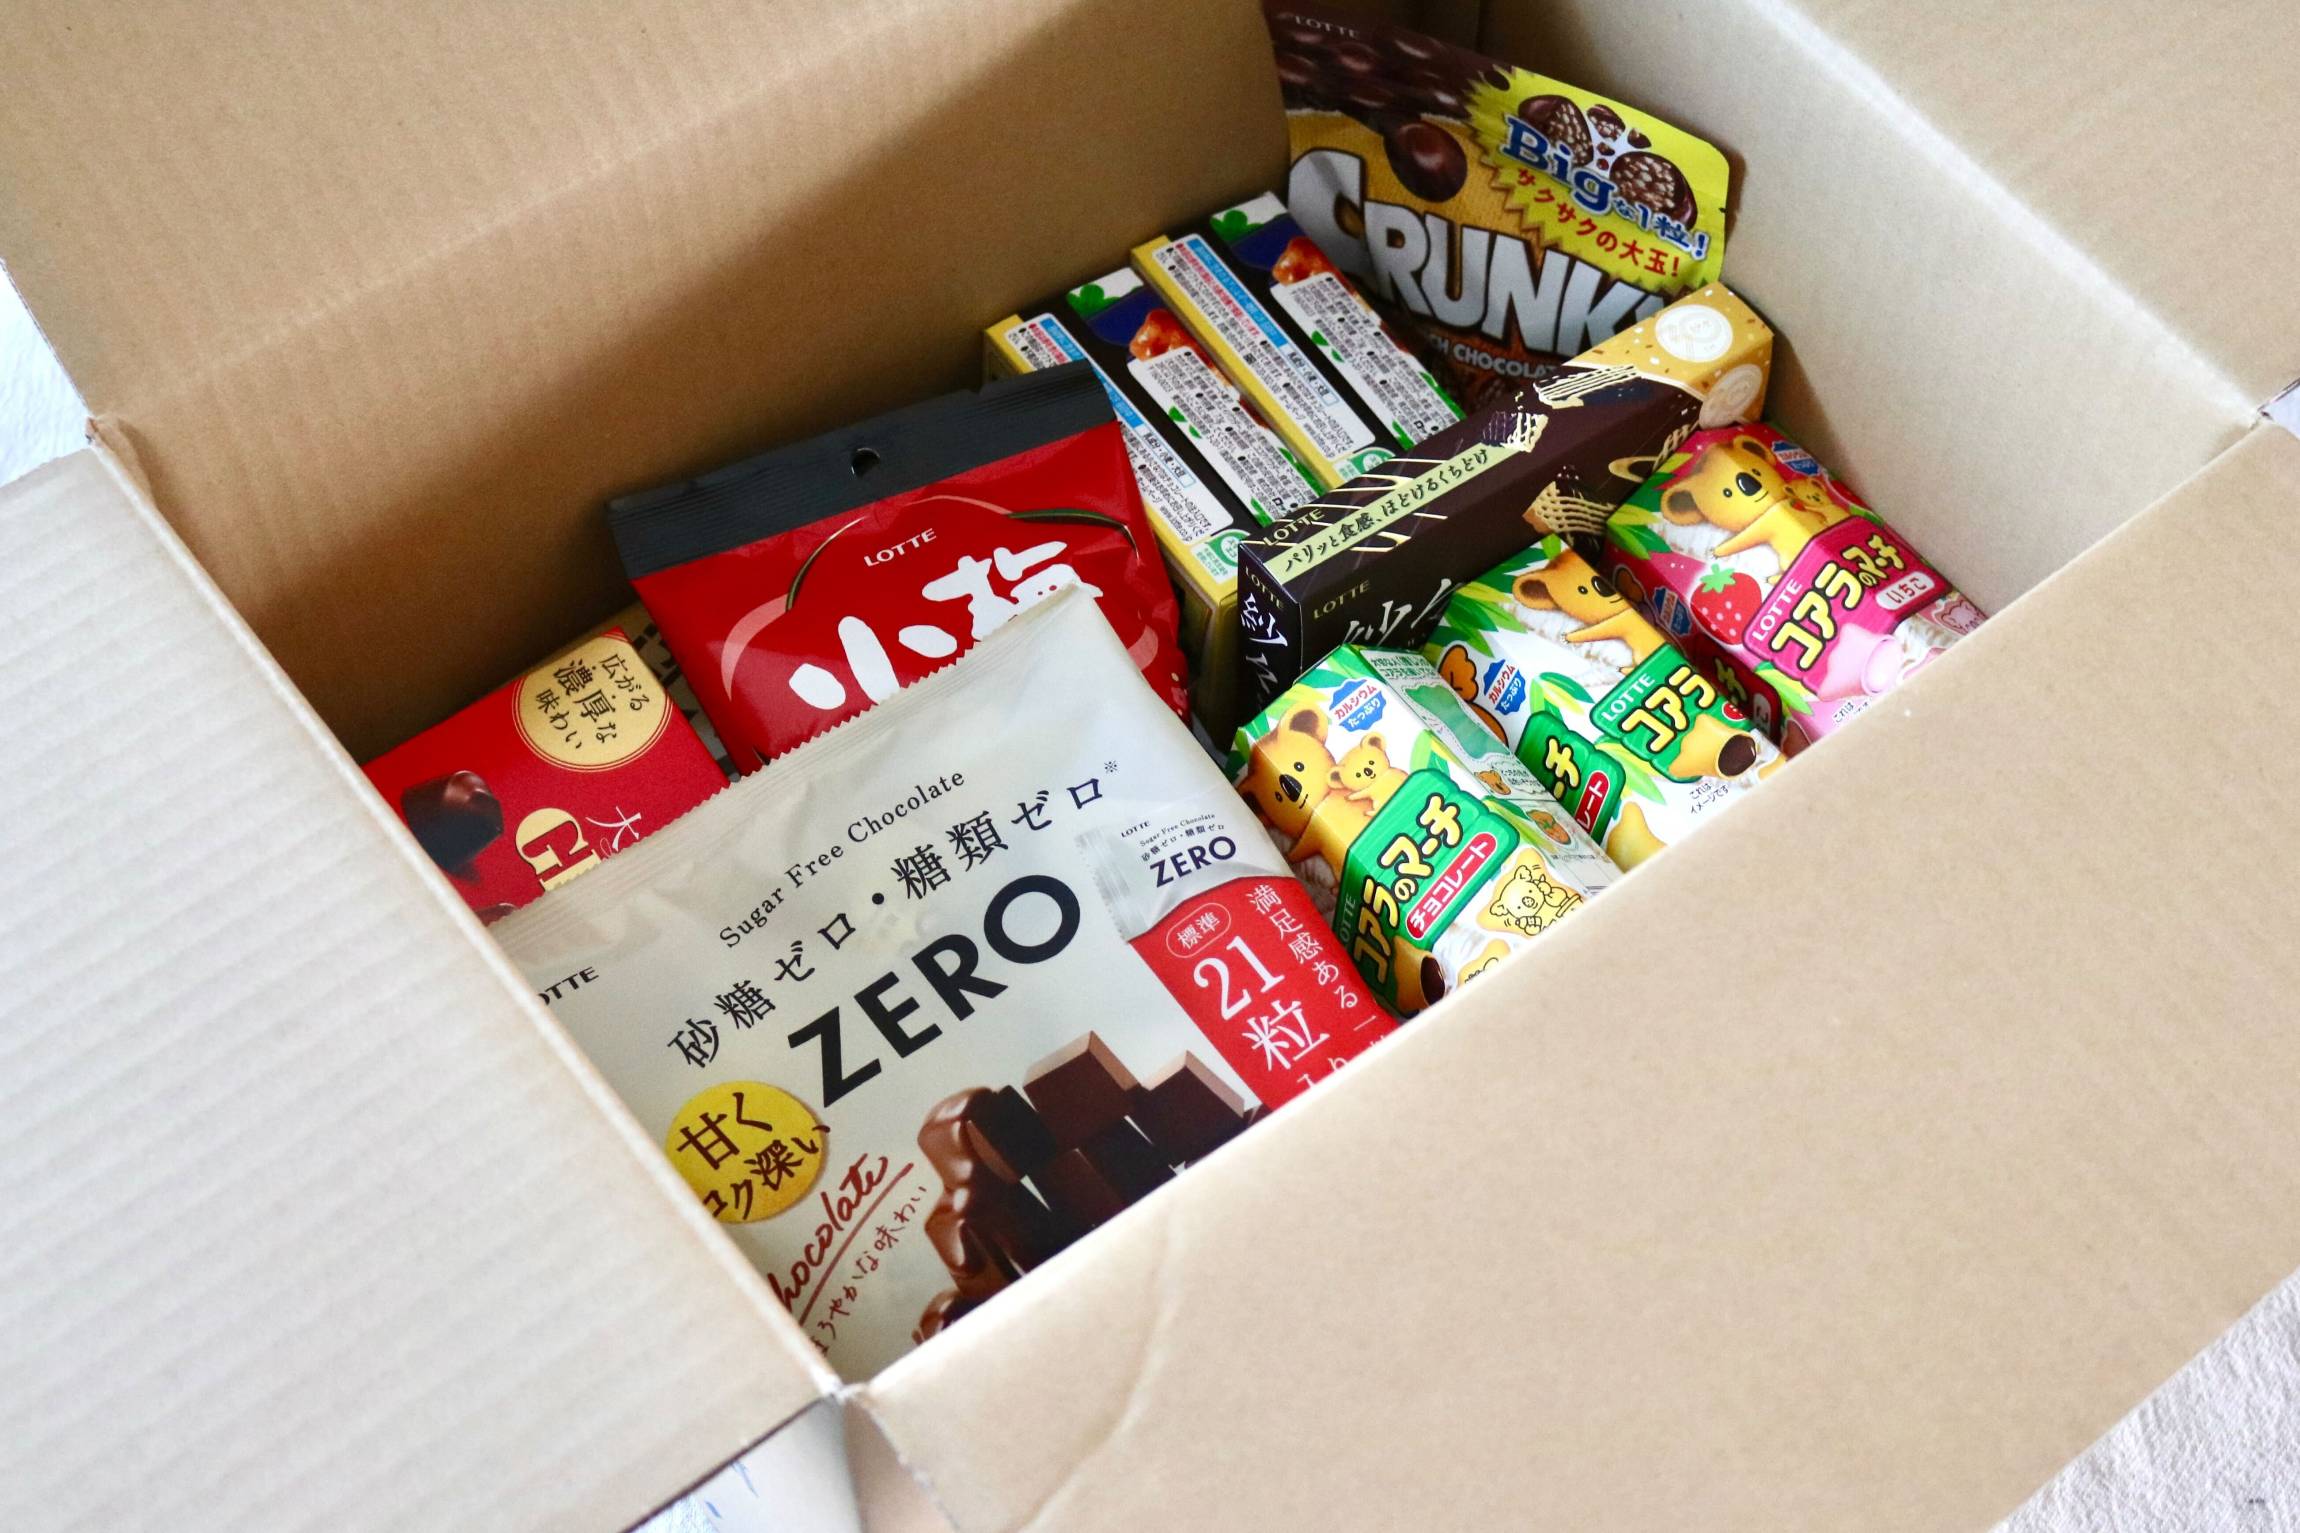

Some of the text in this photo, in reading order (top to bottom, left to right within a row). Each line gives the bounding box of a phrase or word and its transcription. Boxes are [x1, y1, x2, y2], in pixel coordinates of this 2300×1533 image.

[1516, 167, 1682, 278] サクサクの大玉!
[1288, 148, 1666, 360] CRUNK
[864, 528, 938, 567] LOTTE
[1262, 507, 1326, 548] LOTTE
[1245, 566, 1285, 610] LOTTE
[1313, 579, 1371, 620] LOTTE
[1750, 578, 1805, 643] LOTTE
[1770, 533, 1906, 672] コアラのマーチ
[553, 658, 618, 744] 濃厚な
[600, 654, 650, 712] 広がる
[1334, 684, 1378, 721] カルシウム
[1487, 663, 1517, 705] カルシウム
[1502, 675, 1523, 713] たっぷり
[1601, 672, 1656, 725] LOTTE
[1620, 665, 1718, 755] コアラ
[535, 688, 583, 750] 味わい
[1347, 698, 1382, 728] たっぷり
[1688, 782, 1713, 801] これは
[1690, 784, 1730, 815] イメージです
[1121, 820, 1151, 838] LOTTE
[1139, 813, 1216, 848] Sugar Free Chocolate
[718, 768, 966, 950] Sugar Free Chocolate
[1149, 835, 1237, 888] ZERO
[1411, 838, 1491, 934] チョコレート
[1353, 792, 1465, 986] コアラのマーチ
[1177, 911, 1222, 951] 標準
[1338, 893, 1357, 944] OTTE
[786, 873, 1082, 1109] ZERO
[1193, 934, 1286, 1021] 21
[1241, 998, 1331, 1072] 粒
[676, 1091, 774, 1171] 甘く
[767, 1152, 890, 1312] hocolate
